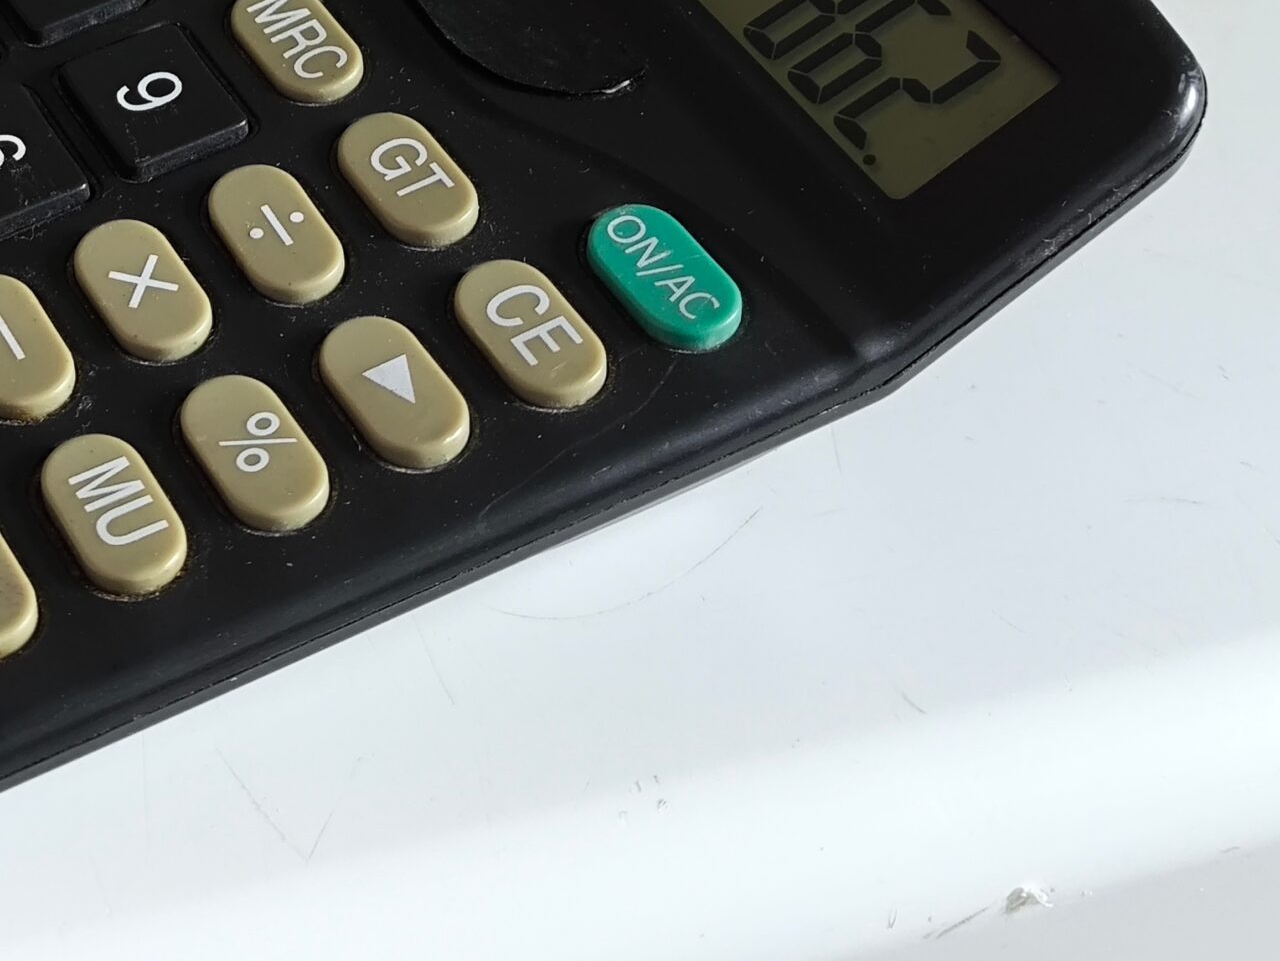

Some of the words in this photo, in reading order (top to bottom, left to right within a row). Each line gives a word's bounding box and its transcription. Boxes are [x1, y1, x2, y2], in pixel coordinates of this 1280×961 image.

[116, 71, 183, 112] 9
[371, 136, 456, 198] GT
[606, 214, 721, 320] ON/AC
[487, 282, 584, 366] CE
[218, 410, 299, 473] %
[68, 454, 169, 546] MU
